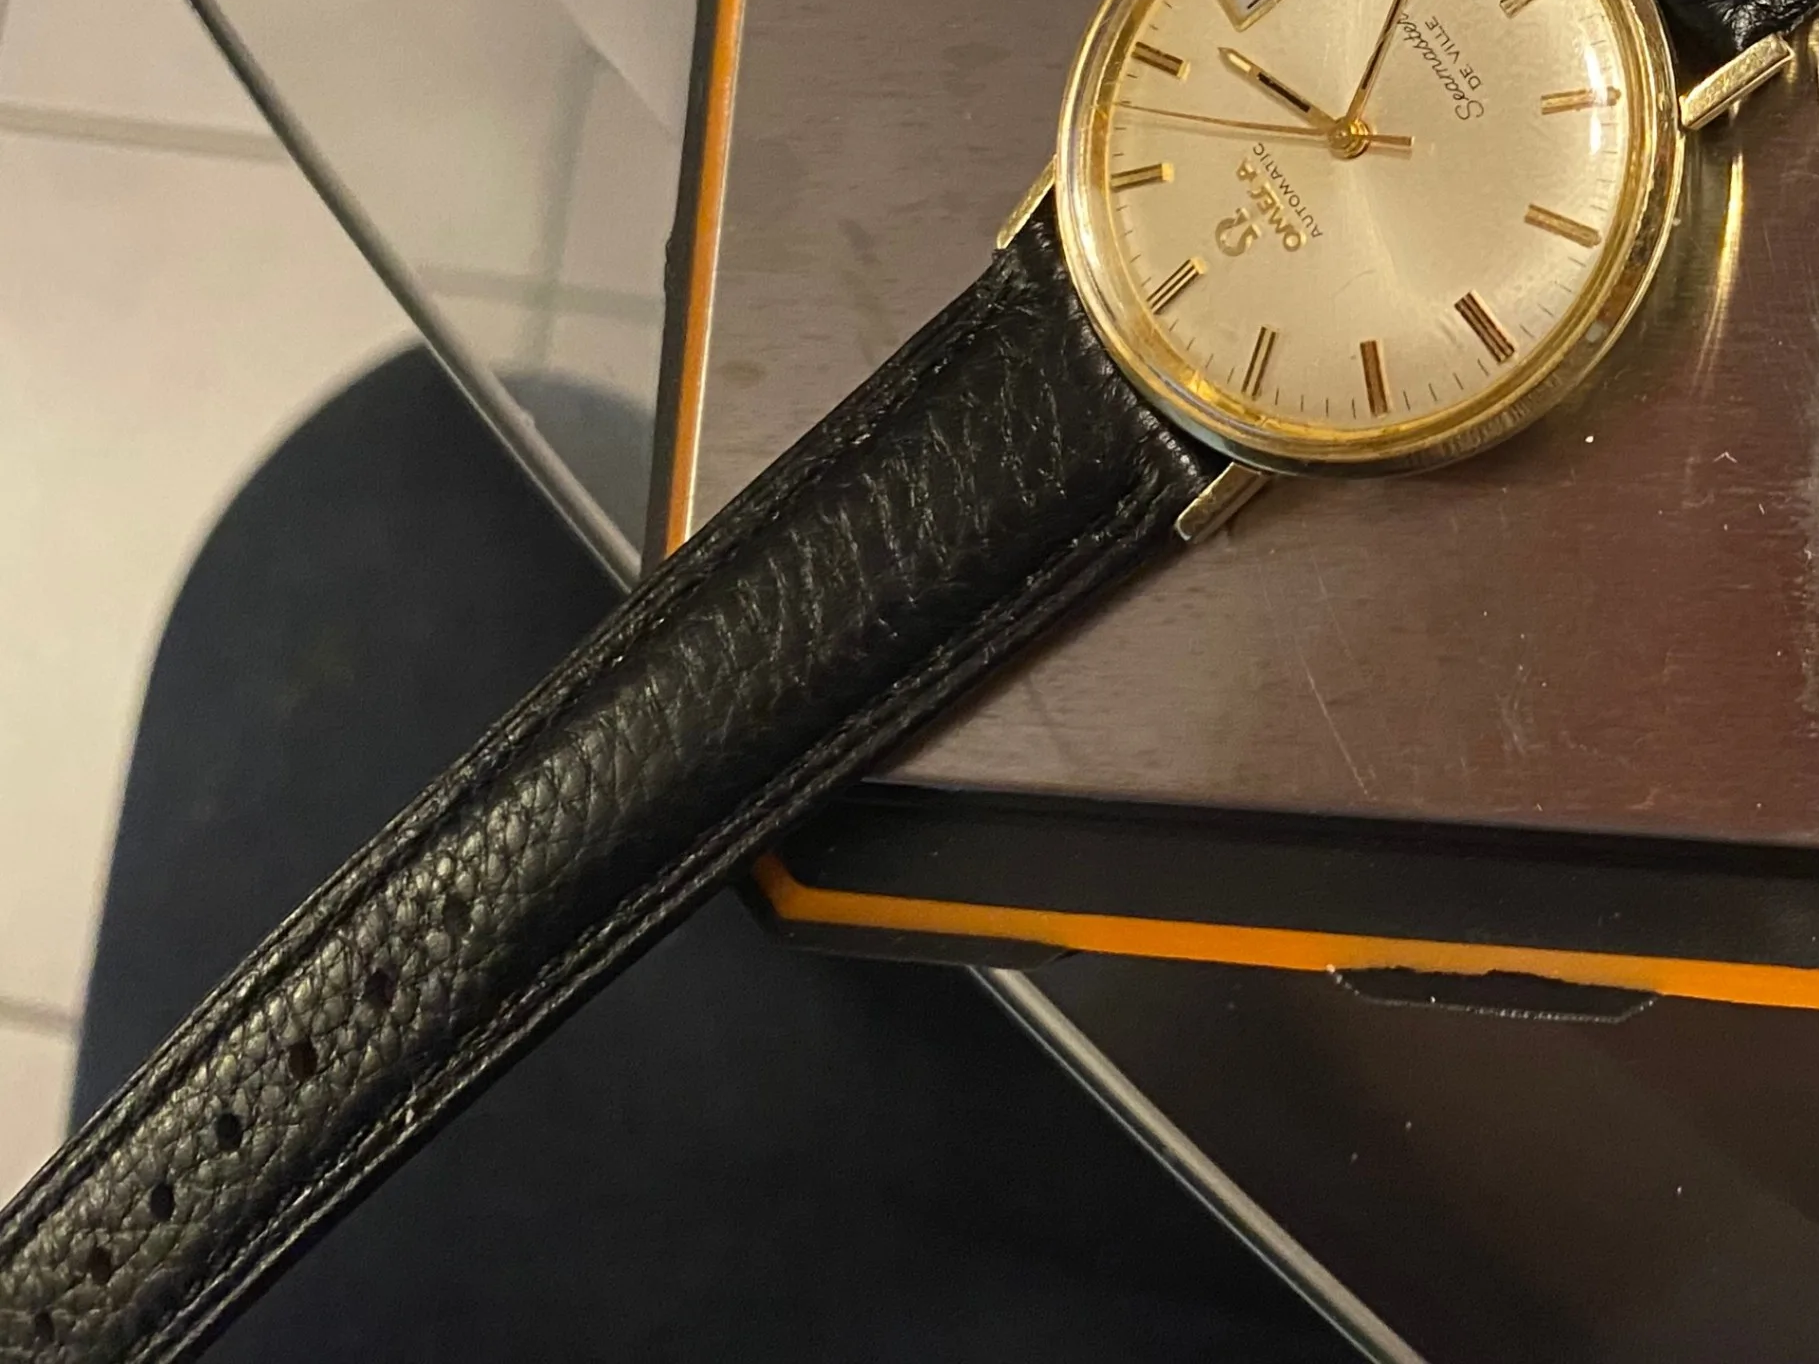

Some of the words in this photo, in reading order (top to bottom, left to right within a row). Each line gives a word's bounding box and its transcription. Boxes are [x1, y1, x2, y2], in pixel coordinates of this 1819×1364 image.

[1396, 12, 1484, 120] Seamaster
[1424, 15, 1461, 65] VILLE
[1459, 63, 1482, 91] DE
[1252, 142, 1323, 238] AUTOMATIC
